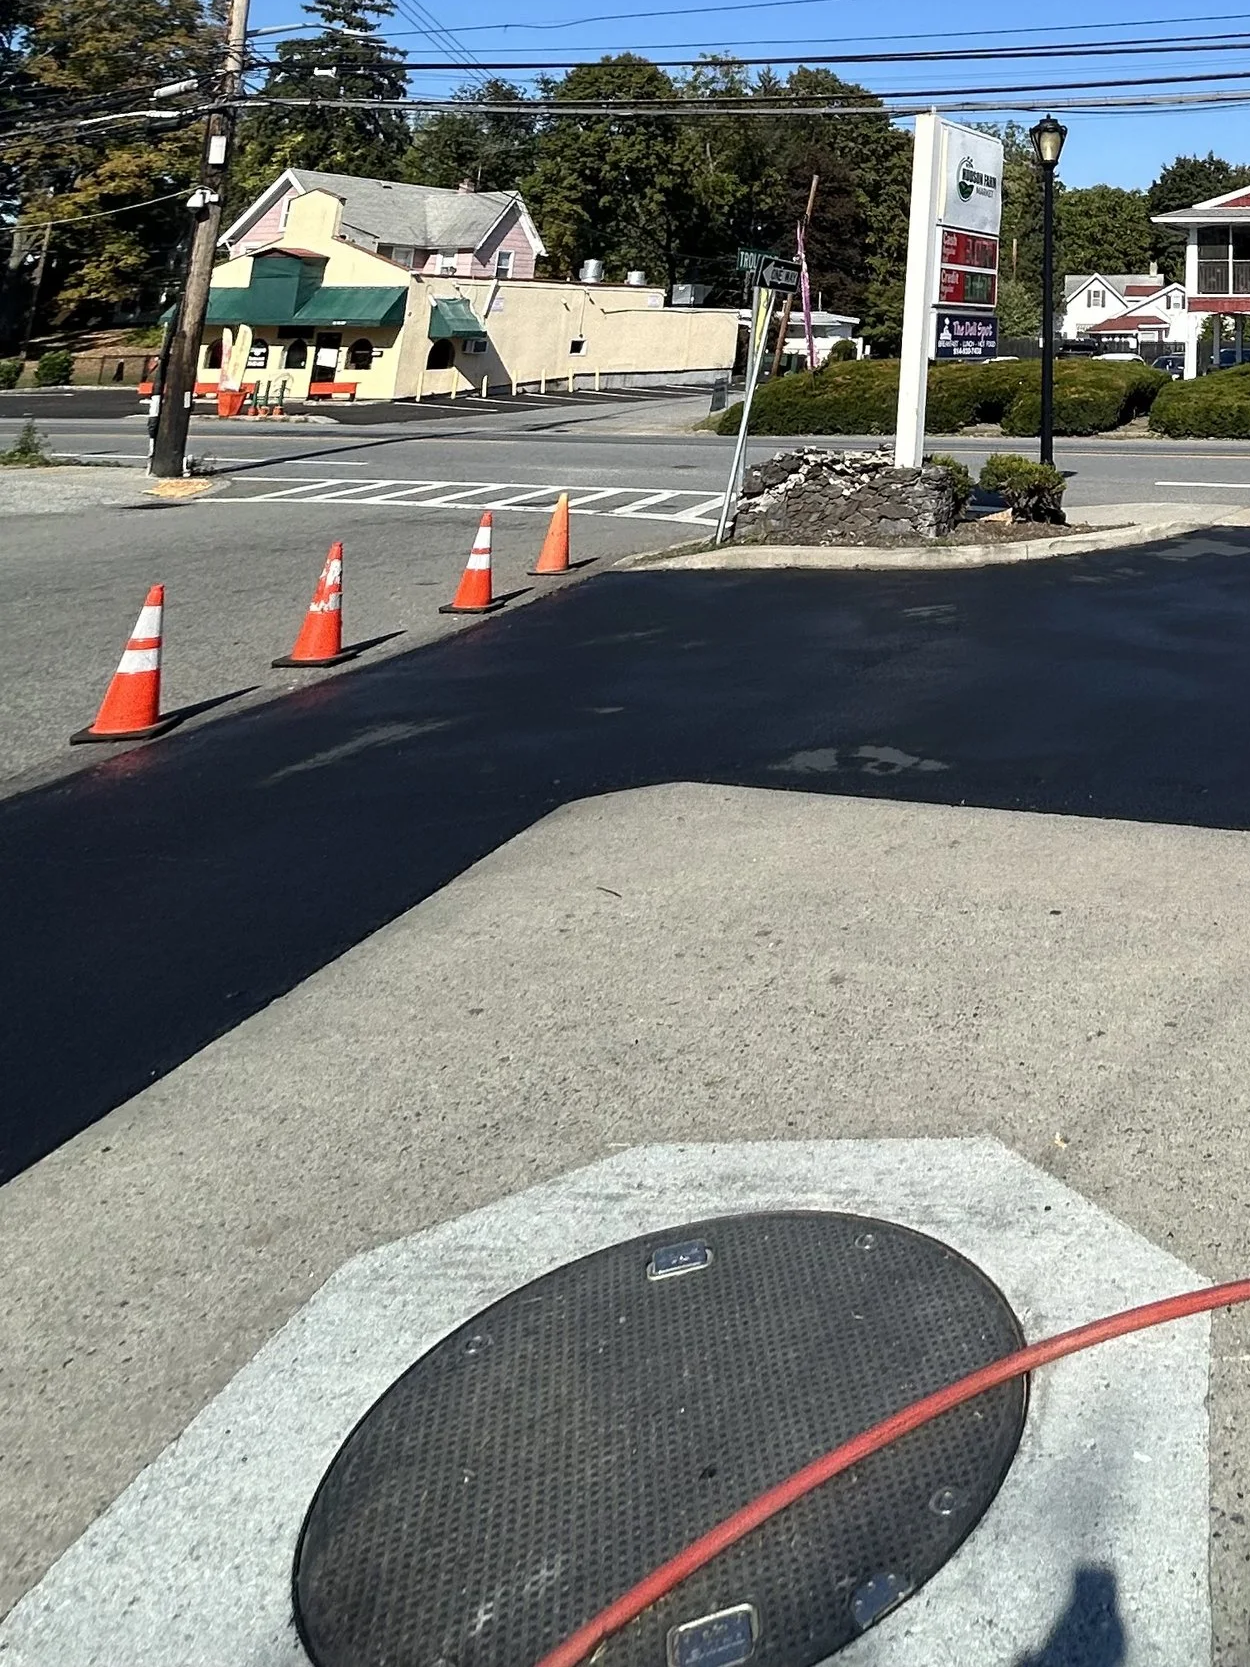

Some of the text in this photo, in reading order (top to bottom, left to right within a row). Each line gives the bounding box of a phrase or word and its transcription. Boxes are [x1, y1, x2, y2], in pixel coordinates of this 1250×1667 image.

[975, 186, 994, 198] MARKET
[953, 320, 964, 336] The
[977, 322, 993, 342] Spot
